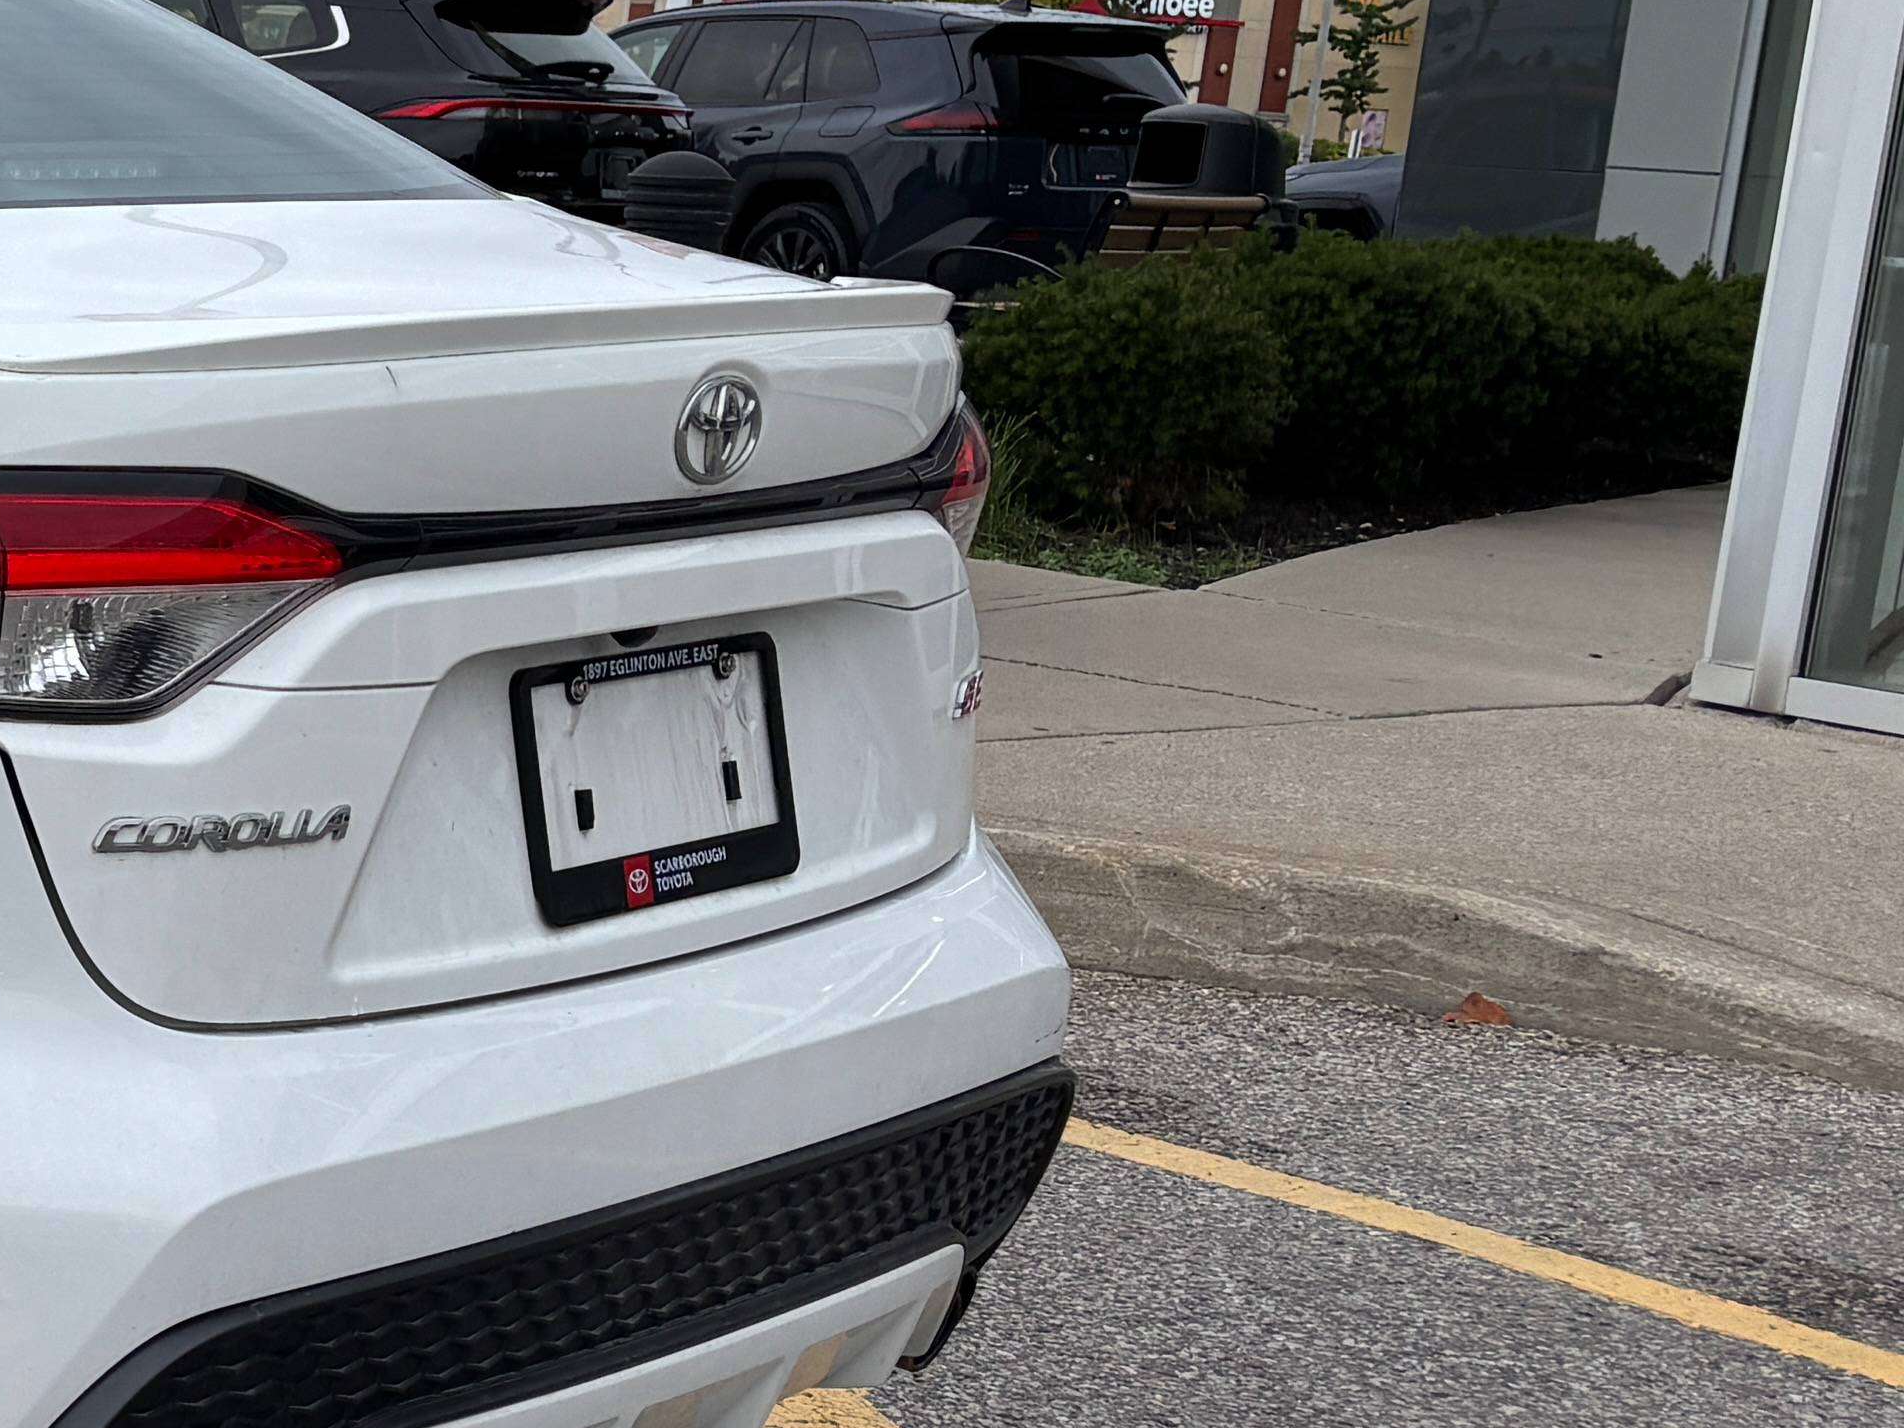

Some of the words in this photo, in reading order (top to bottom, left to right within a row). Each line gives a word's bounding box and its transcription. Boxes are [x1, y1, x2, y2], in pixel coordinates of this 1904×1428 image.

[583, 661, 607, 681] 1897
[610, 652, 666, 677] EGLINTON
[667, 649, 692, 668] AVE.
[693, 644, 719, 663] EAST
[92, 804, 351, 853] COROLLA
[654, 846, 727, 875] SCARBOROUGH
[656, 871, 694, 892] TOYOTA
